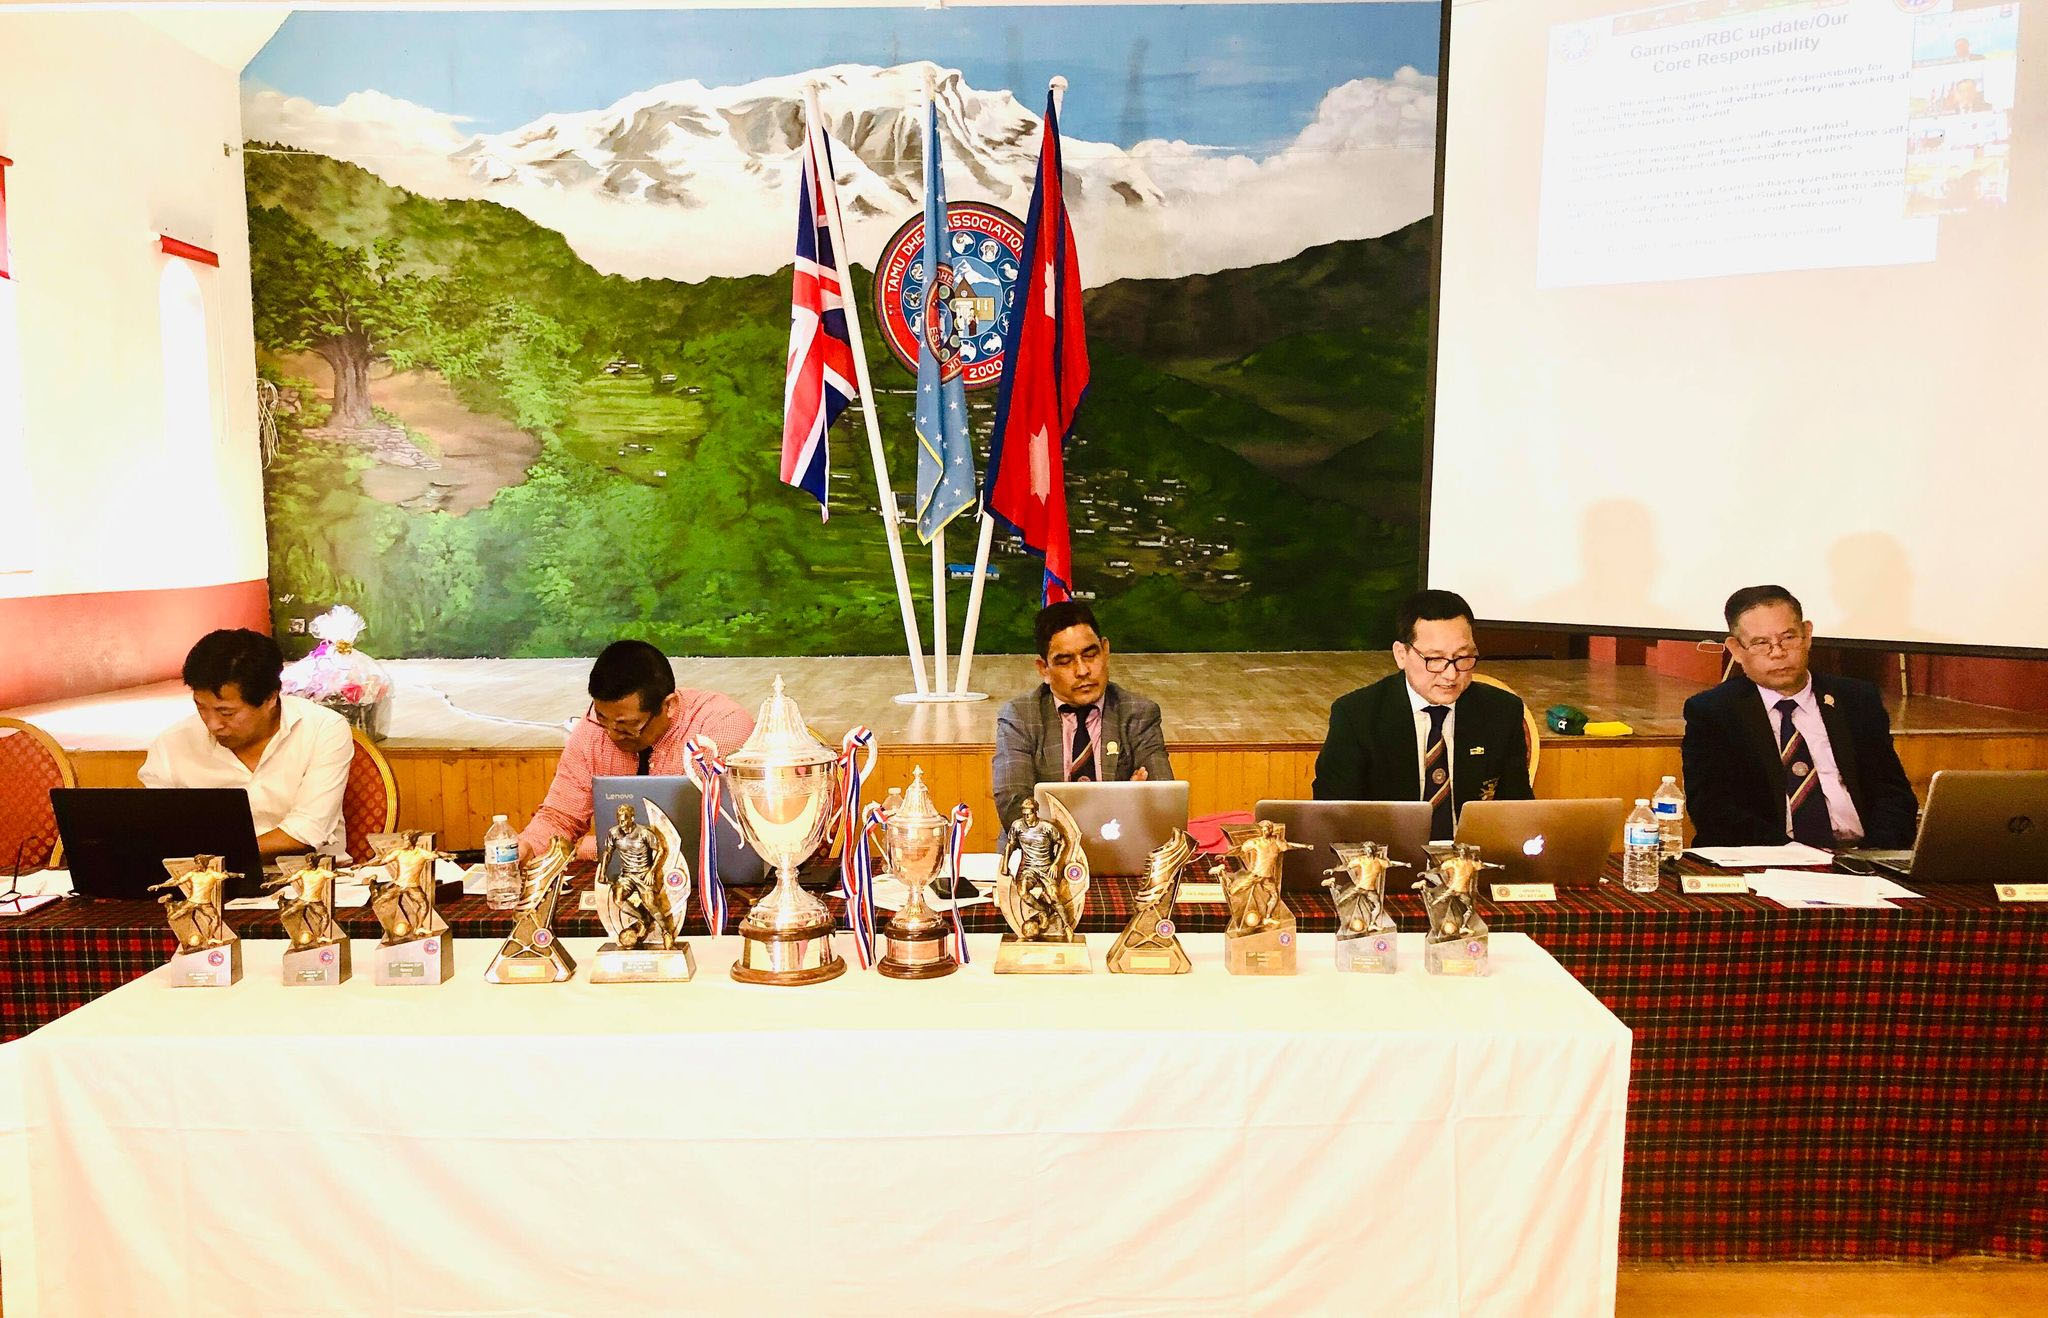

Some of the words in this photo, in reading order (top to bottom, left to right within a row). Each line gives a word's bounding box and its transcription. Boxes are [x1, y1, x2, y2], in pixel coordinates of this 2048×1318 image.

[1630, 28, 1744, 59] Garrison/RBC
[1750, 13, 1848, 40] update/Our
[1653, 58, 1691, 73] Core
[1697, 37, 1820, 66] Responsibility
[888, 257, 906, 292] TAMU
[969, 359, 1003, 379] 2000
[605, 792, 634, 801] Lenovo
